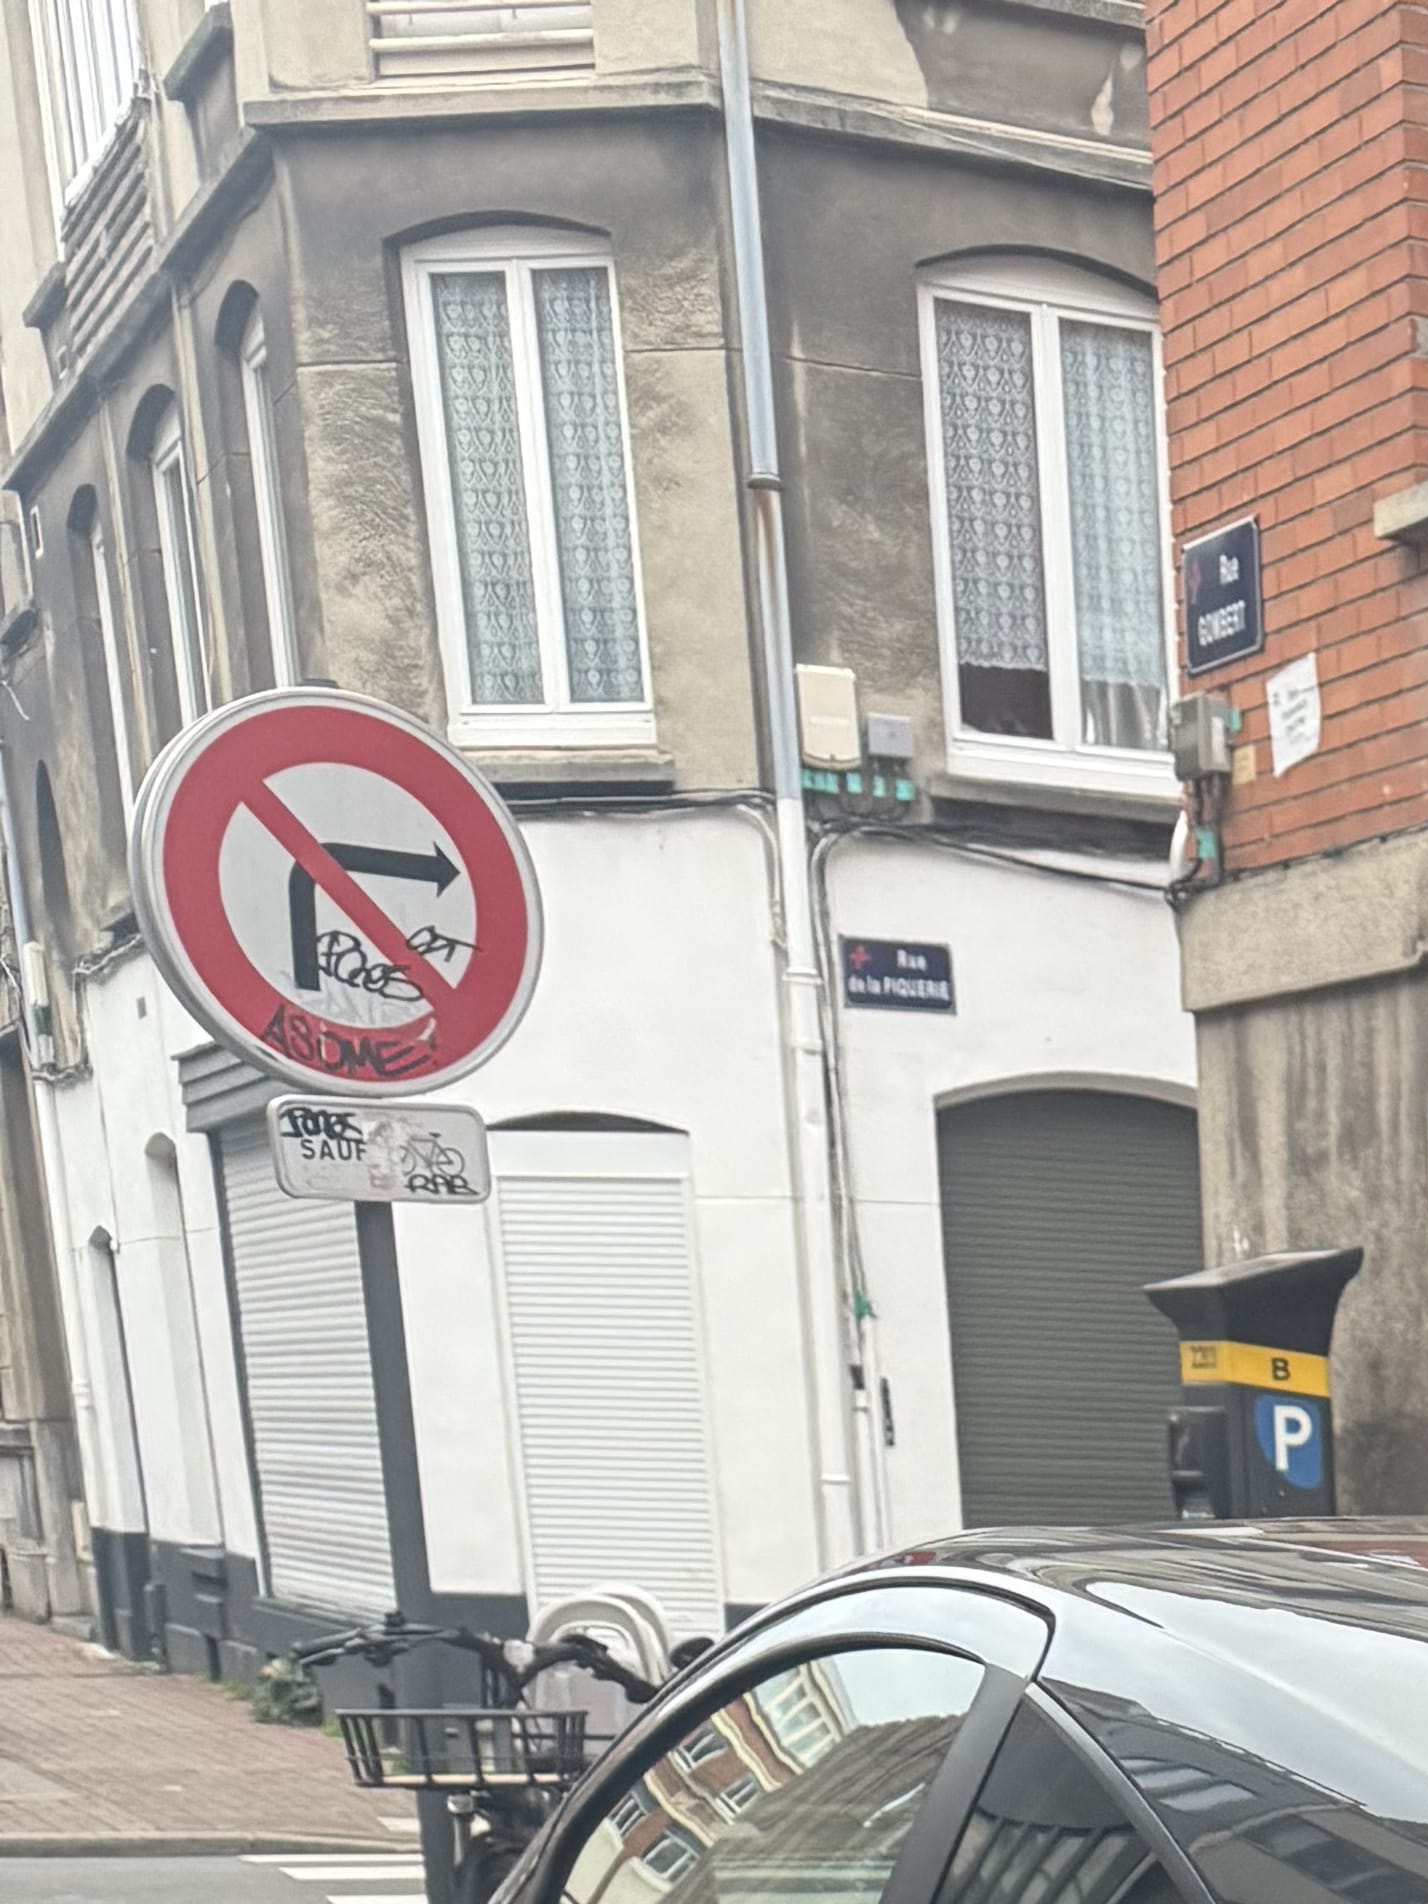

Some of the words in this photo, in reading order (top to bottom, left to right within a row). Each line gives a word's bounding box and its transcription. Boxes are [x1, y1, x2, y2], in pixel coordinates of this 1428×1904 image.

[1219, 554, 1240, 585] Rue
[1198, 599, 1246, 646] GOMBERT
[896, 948, 928, 972] Rue
[847, 974, 865, 994] de
[866, 974, 881, 995] la
[883, 975, 949, 1001] PIQUERIE
[300, 1138, 367, 1161] SAUF
[1272, 1357, 1291, 1381] B
[1274, 1405, 1313, 1471] P
